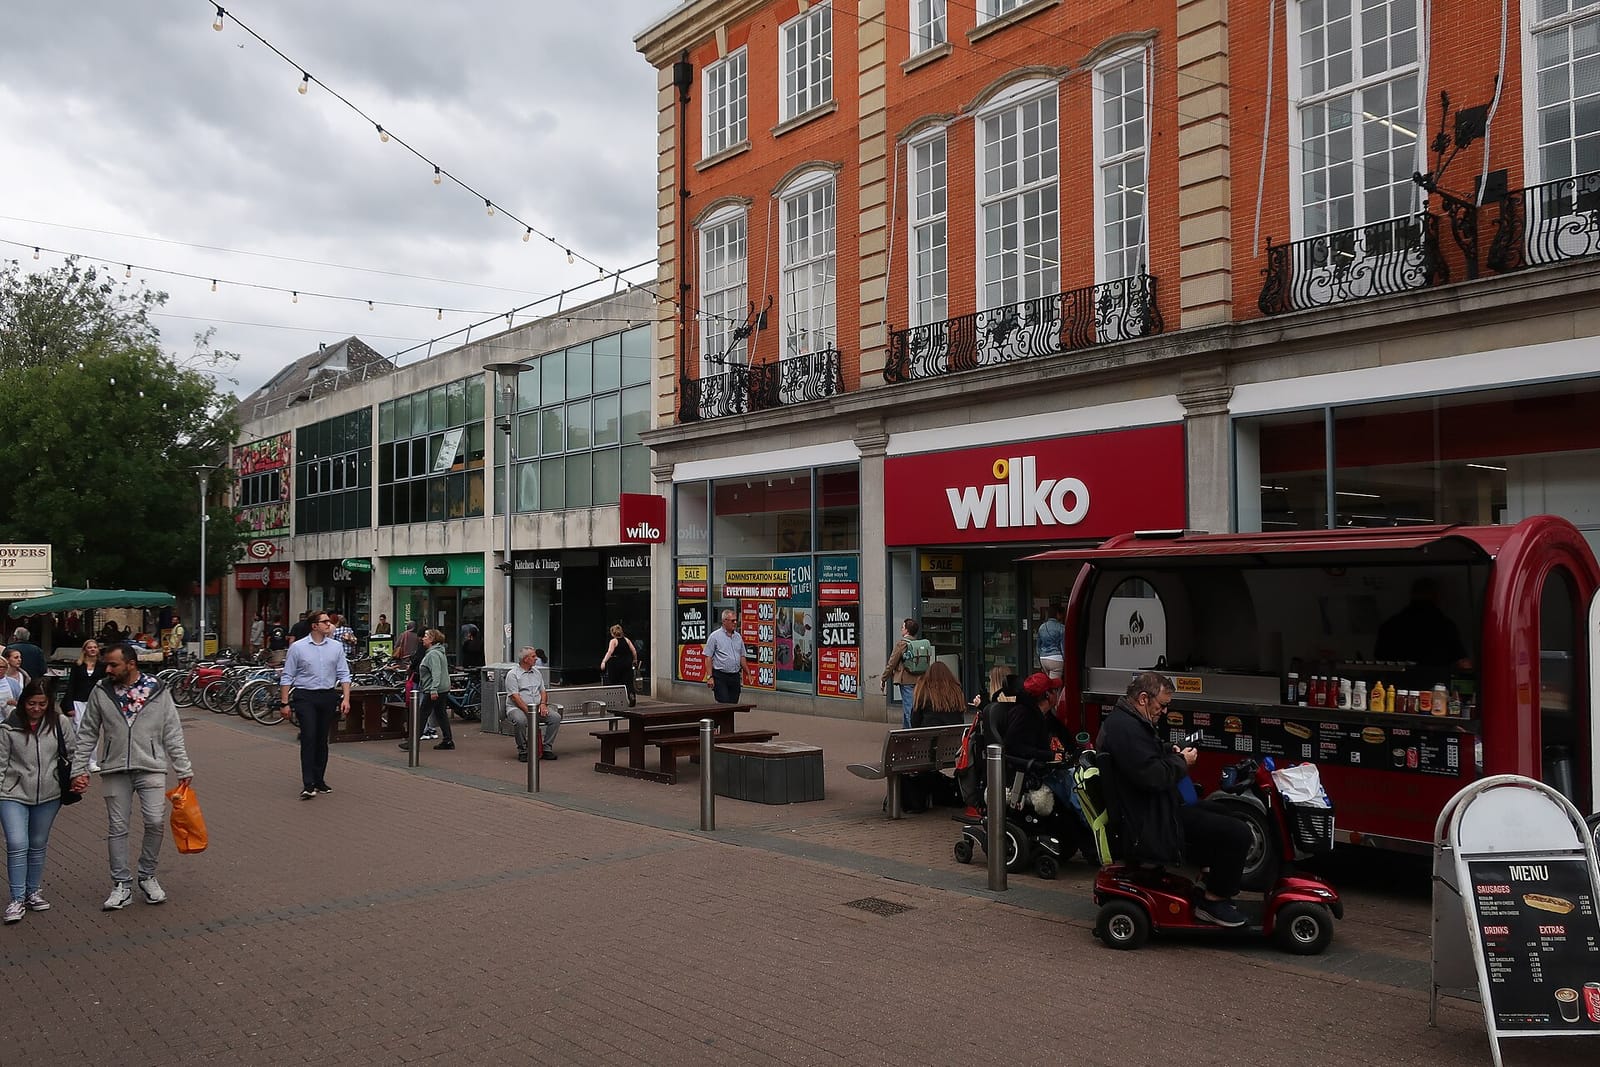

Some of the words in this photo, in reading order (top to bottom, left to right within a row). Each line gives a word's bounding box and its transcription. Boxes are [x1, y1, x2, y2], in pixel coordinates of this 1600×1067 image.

[945, 456, 1090, 530] wilko
[626, 521, 660, 542] wilko
[0, 559, 17, 568] IT
[514, 560, 535, 571] Kitchen
[535, 560, 541, 569] &
[542, 559, 561, 572] Things
[610, 556, 635, 569] Kitchen
[636, 556, 643, 567] &
[930, 559, 954, 570] SALE
[685, 571, 700, 580] SALE
[727, 573, 772, 582] ADMINISTRATION
[773, 573, 787, 581] SALE
[798, 565, 811, 583] ON
[726, 586, 760, 598] EVERYTHING
[760, 586, 776, 597] MUST
[777, 586, 789, 598] GO!
[684, 608, 702, 621] wilko
[826, 607, 850, 623] wilko
[682, 626, 706, 641] SALE
[822, 629, 855, 646] SALE
[1509, 865, 1549, 881] MENU
[1477, 885, 1511, 894] SAUSAGES
[1539, 925, 1565, 934] EXTRAS
